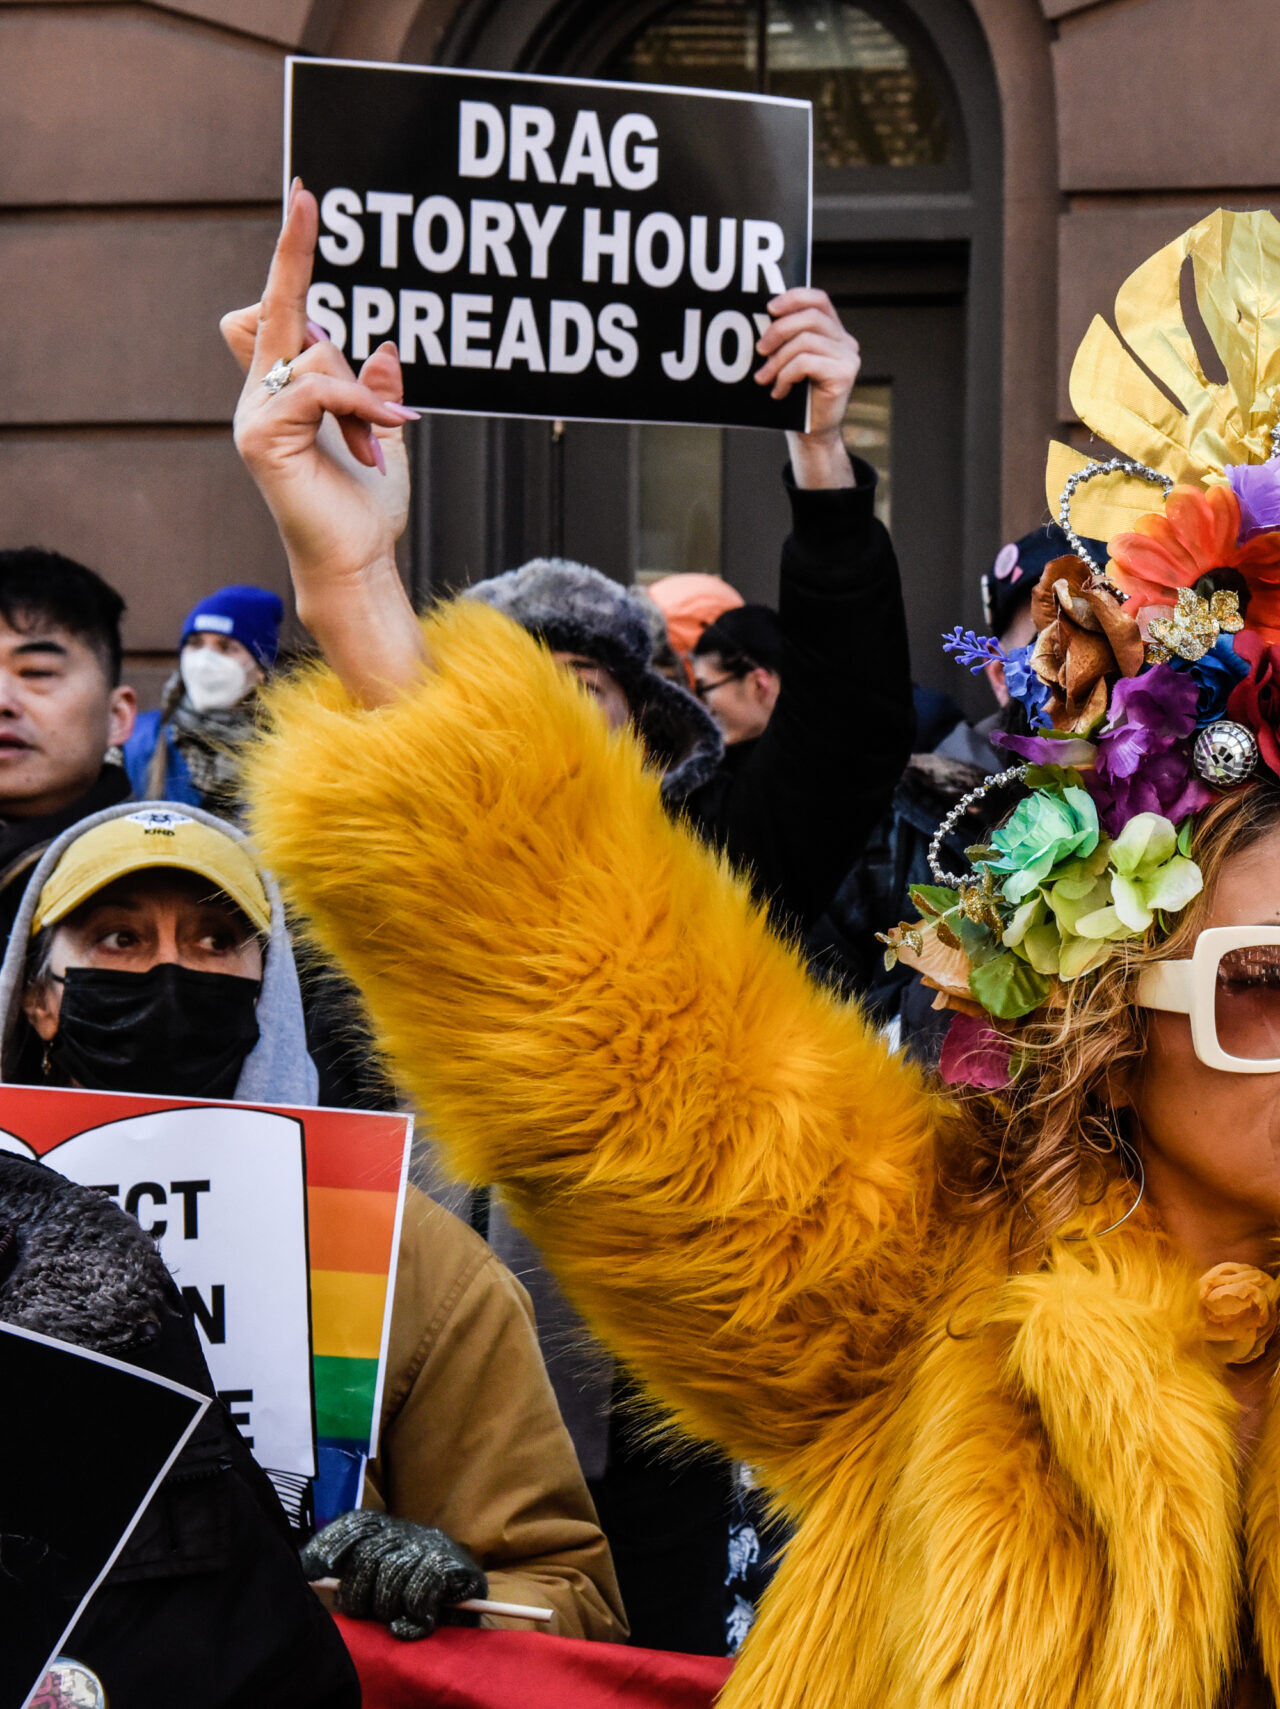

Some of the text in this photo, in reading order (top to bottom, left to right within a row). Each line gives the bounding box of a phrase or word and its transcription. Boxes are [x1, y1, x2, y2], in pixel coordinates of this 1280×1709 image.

[458, 100, 660, 191] DRAG
[318, 187, 787, 295] STORY HOUR
[306, 282, 771, 385] SPREADS JO
